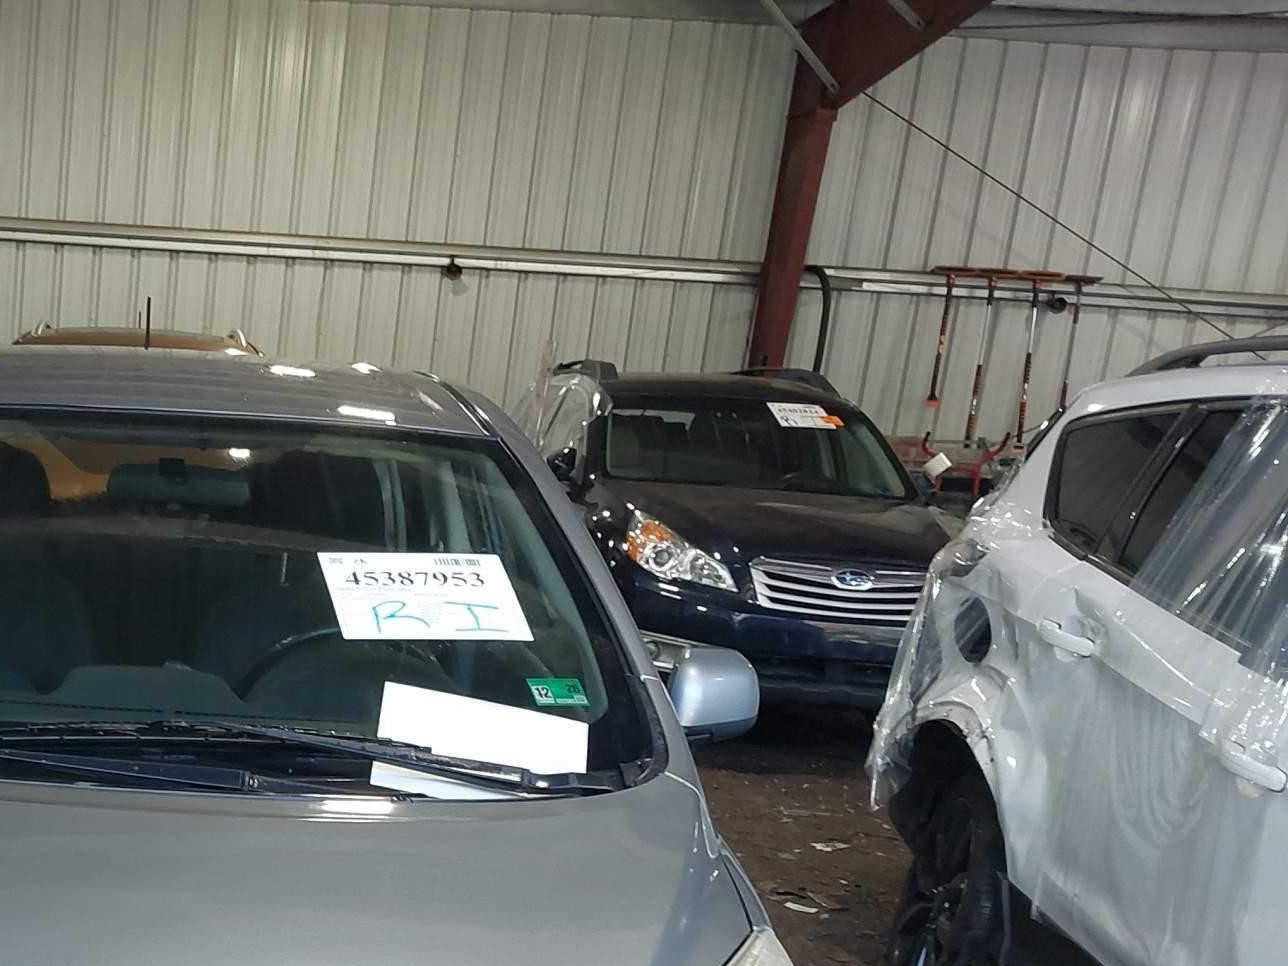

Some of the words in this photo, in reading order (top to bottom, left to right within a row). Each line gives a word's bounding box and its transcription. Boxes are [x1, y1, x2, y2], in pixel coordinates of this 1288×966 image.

[345, 570, 486, 588] 45387953
[371, 600, 432, 633] R
[534, 686, 553, 699] 12
